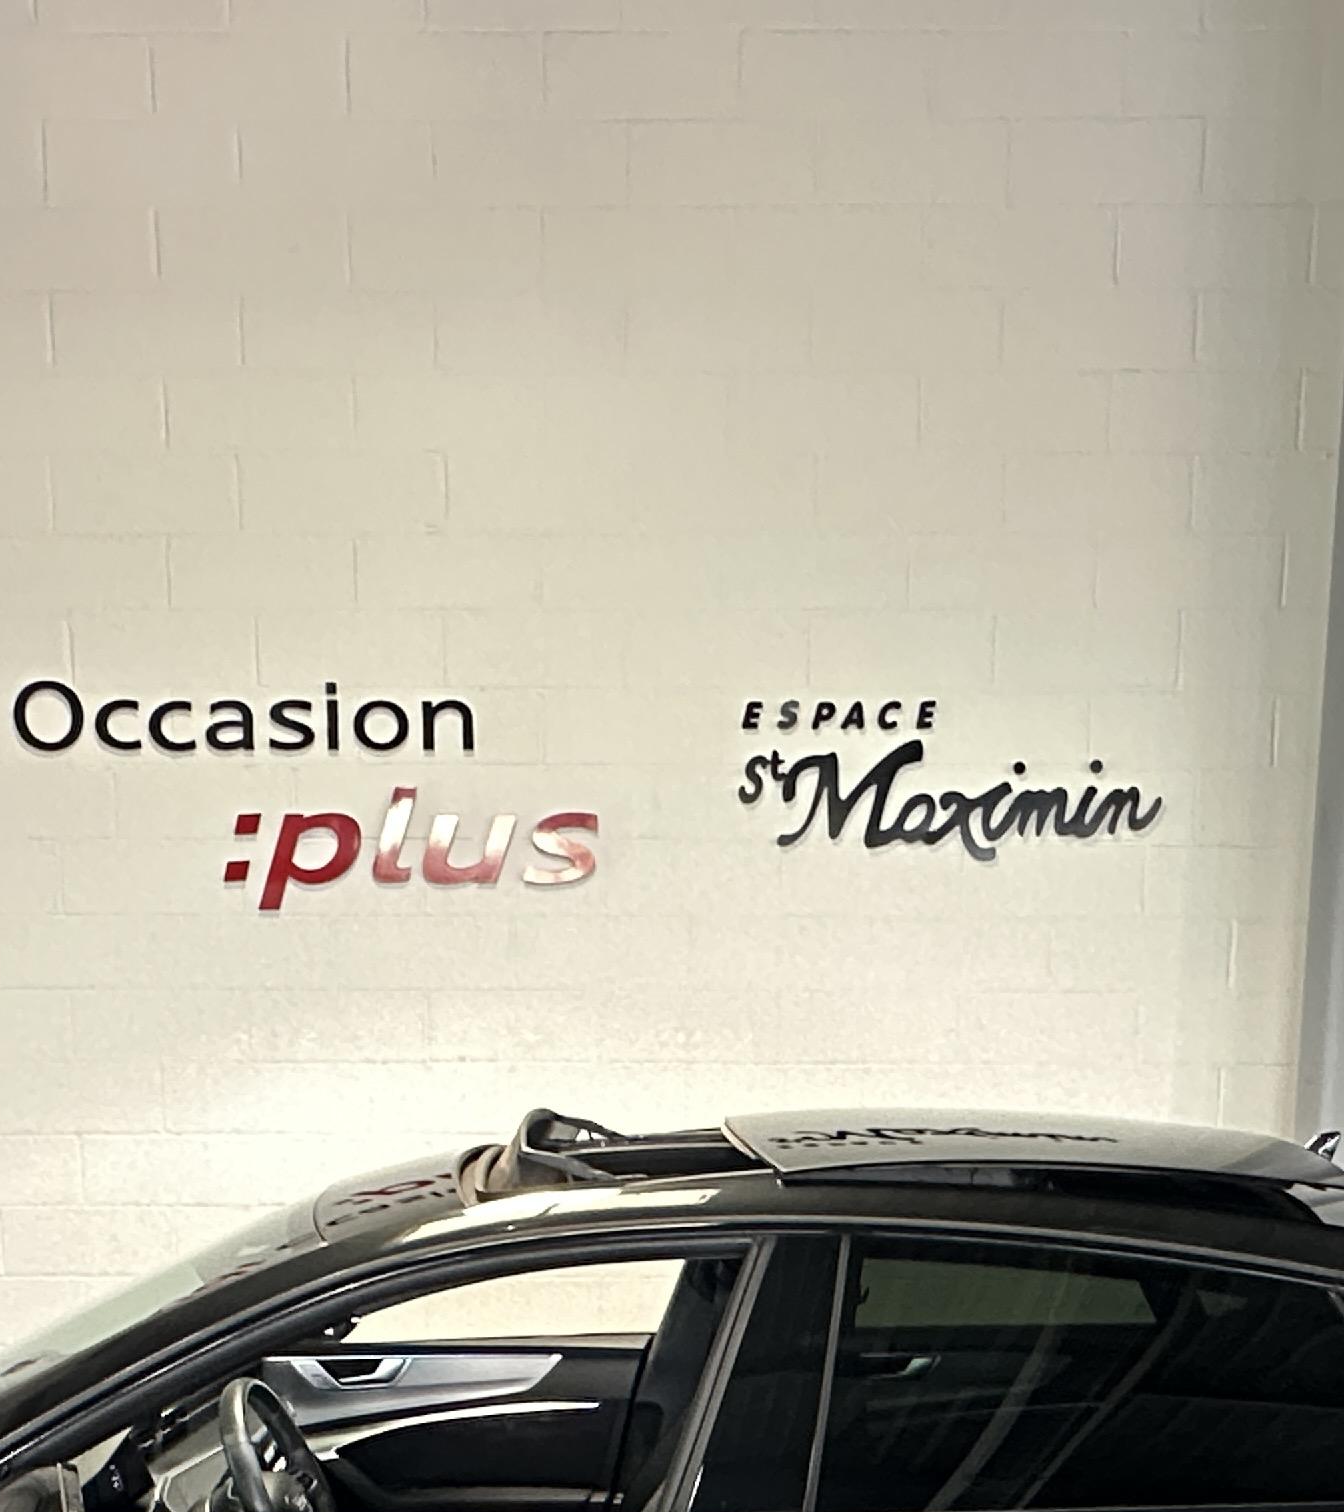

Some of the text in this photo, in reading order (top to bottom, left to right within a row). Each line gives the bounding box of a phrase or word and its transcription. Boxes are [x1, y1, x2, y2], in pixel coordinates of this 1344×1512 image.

[12, 680, 477, 753] Occasion
[741, 700, 937, 731] ESPACE
[738, 738, 1162, 861] St Maximin
